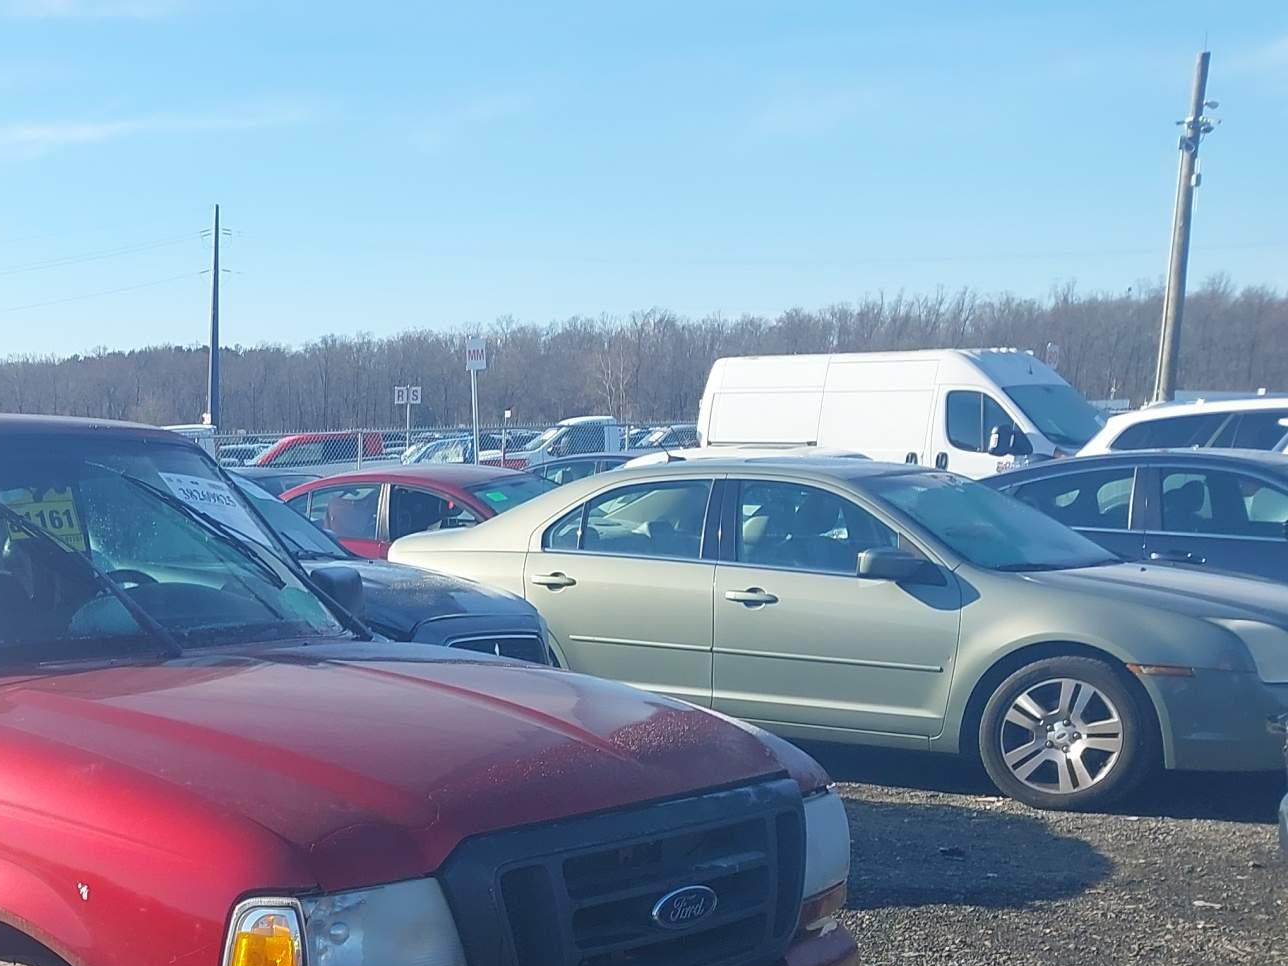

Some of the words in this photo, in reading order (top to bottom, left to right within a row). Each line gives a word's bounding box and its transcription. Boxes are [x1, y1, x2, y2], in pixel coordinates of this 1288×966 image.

[467, 349, 485, 361] MM
[397, 389, 404, 401] R
[412, 389, 419, 401] S
[670, 894, 705, 921] Ford
